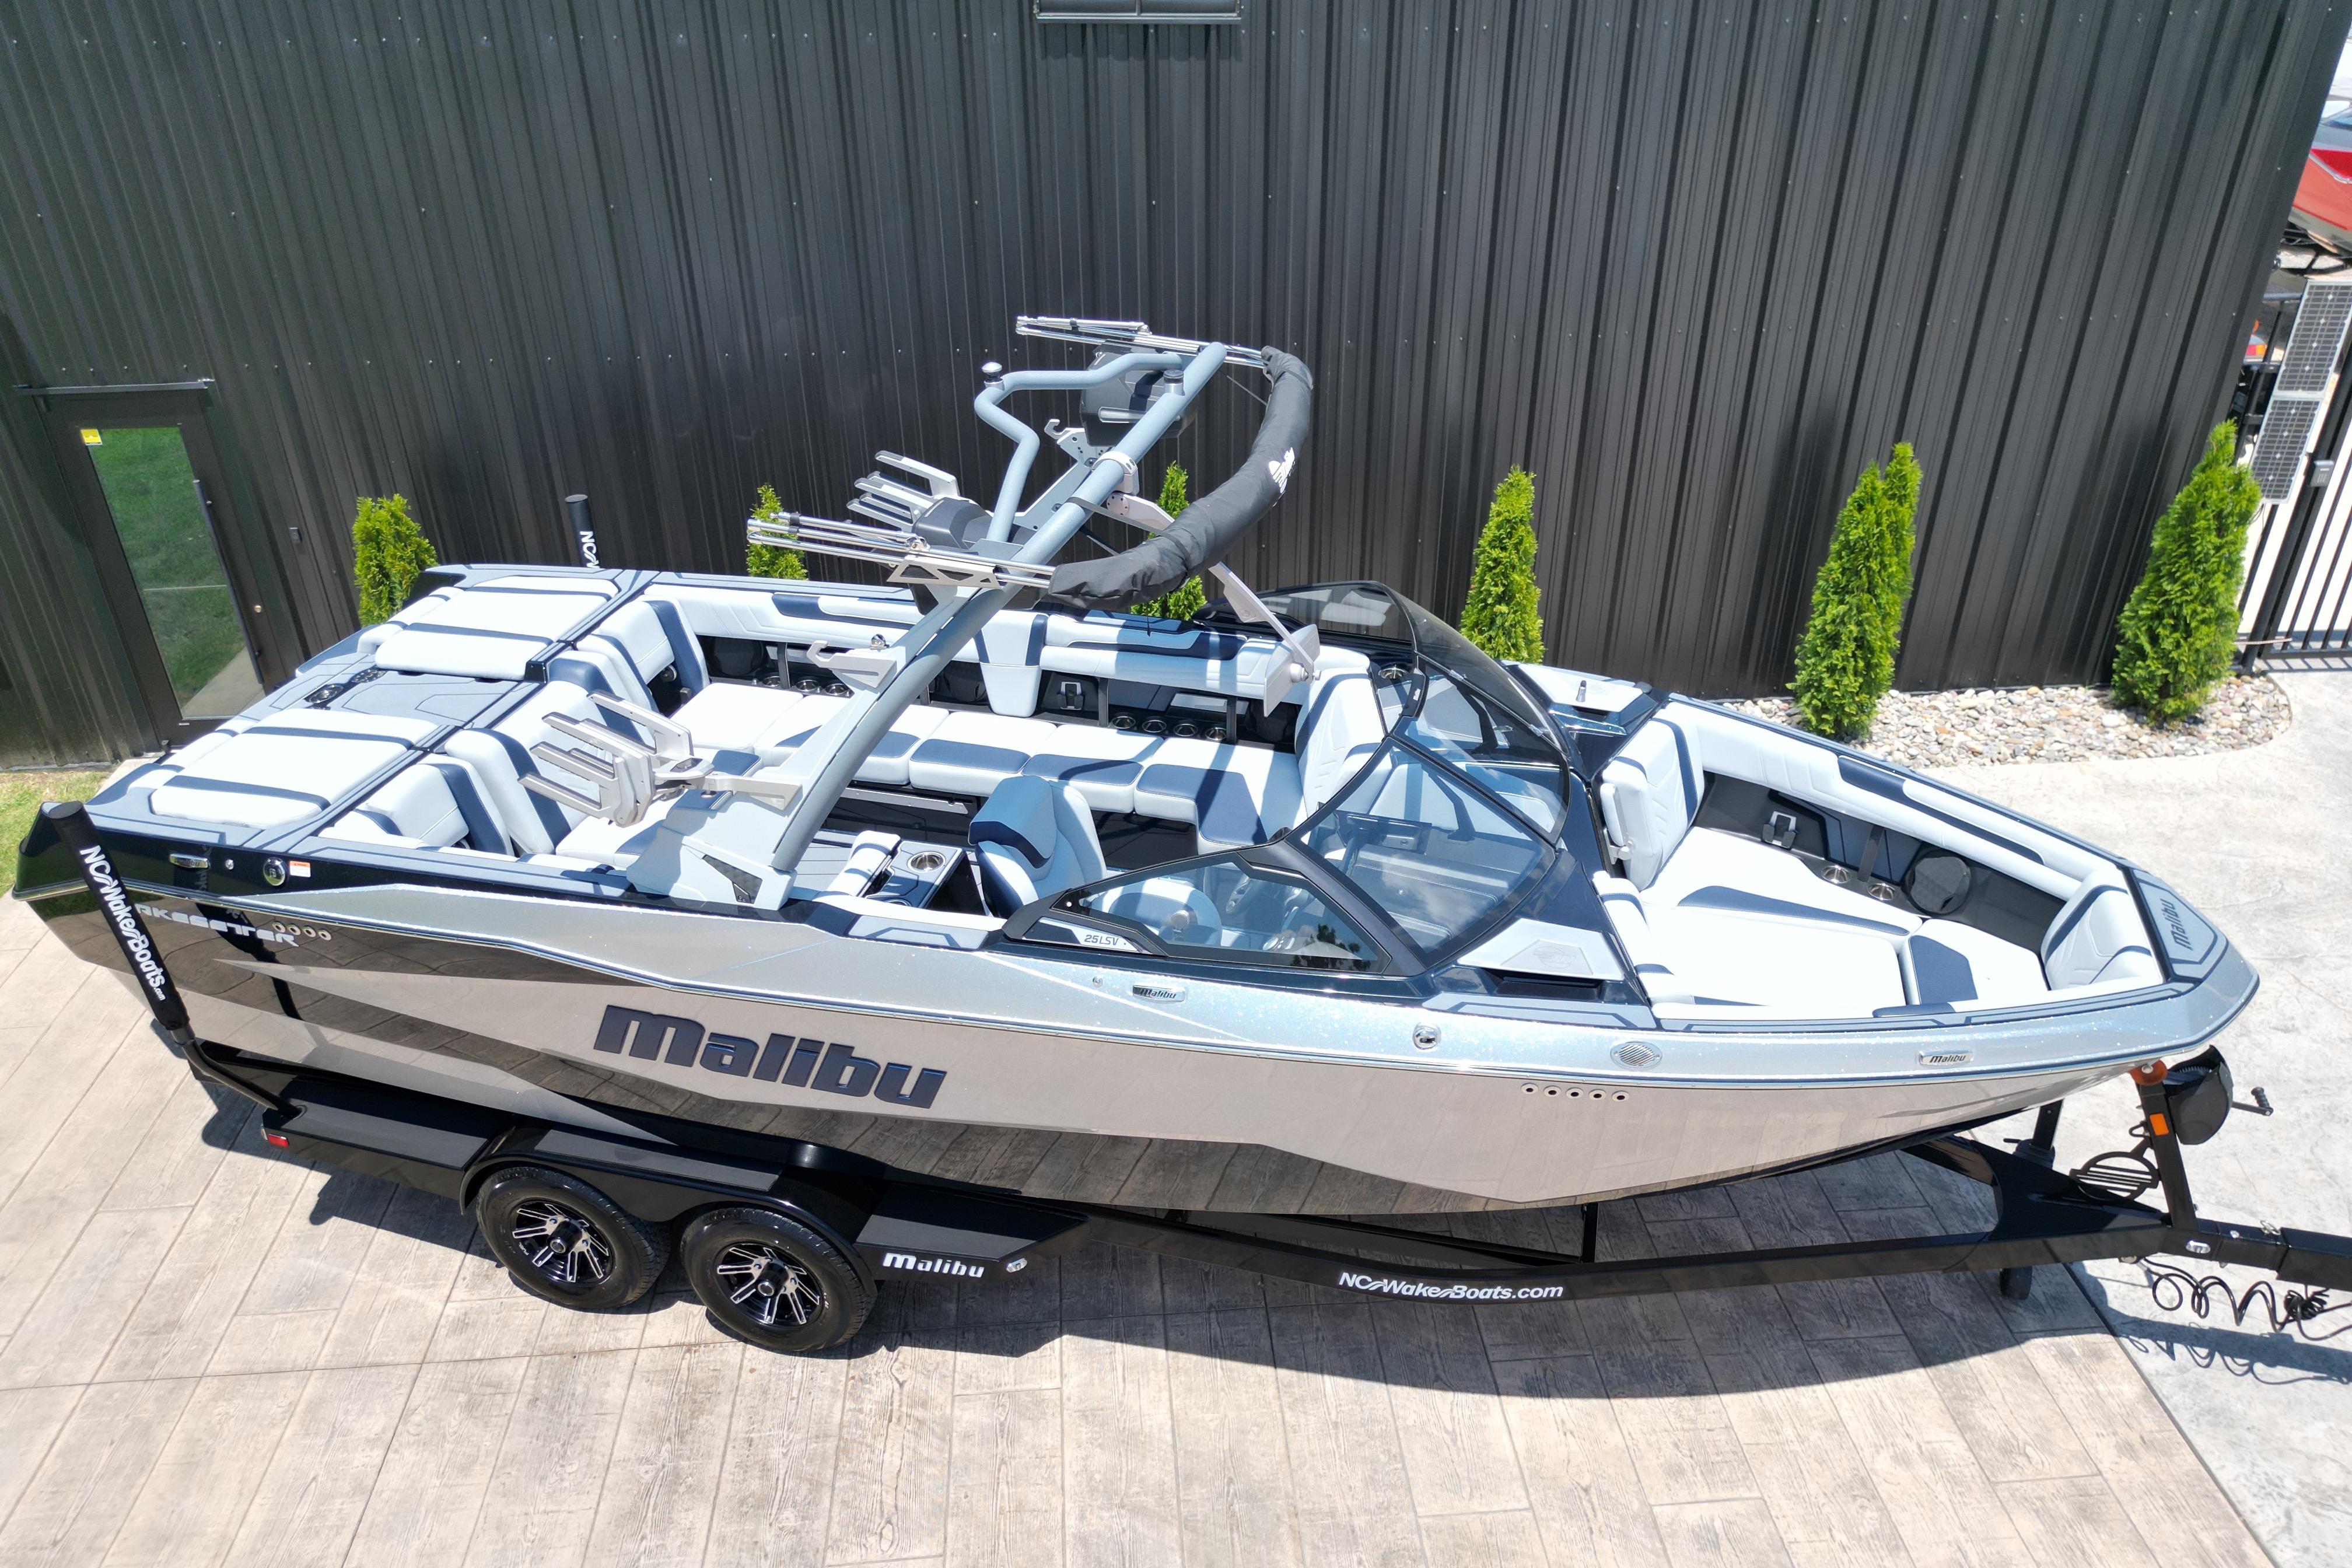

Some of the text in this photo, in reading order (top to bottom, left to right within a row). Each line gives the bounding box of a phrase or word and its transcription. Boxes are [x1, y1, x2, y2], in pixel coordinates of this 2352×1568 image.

[134, 903, 299, 947] AKESETTER
[2160, 898, 2193, 951] Malibu
[1084, 935, 1119, 946] 25LSV
[1139, 988, 1177, 999] Malibu
[593, 1005, 947, 1109] Malibu
[1930, 1054, 1966, 1063] Malibu
[883, 1252, 985, 1278] Malibu
